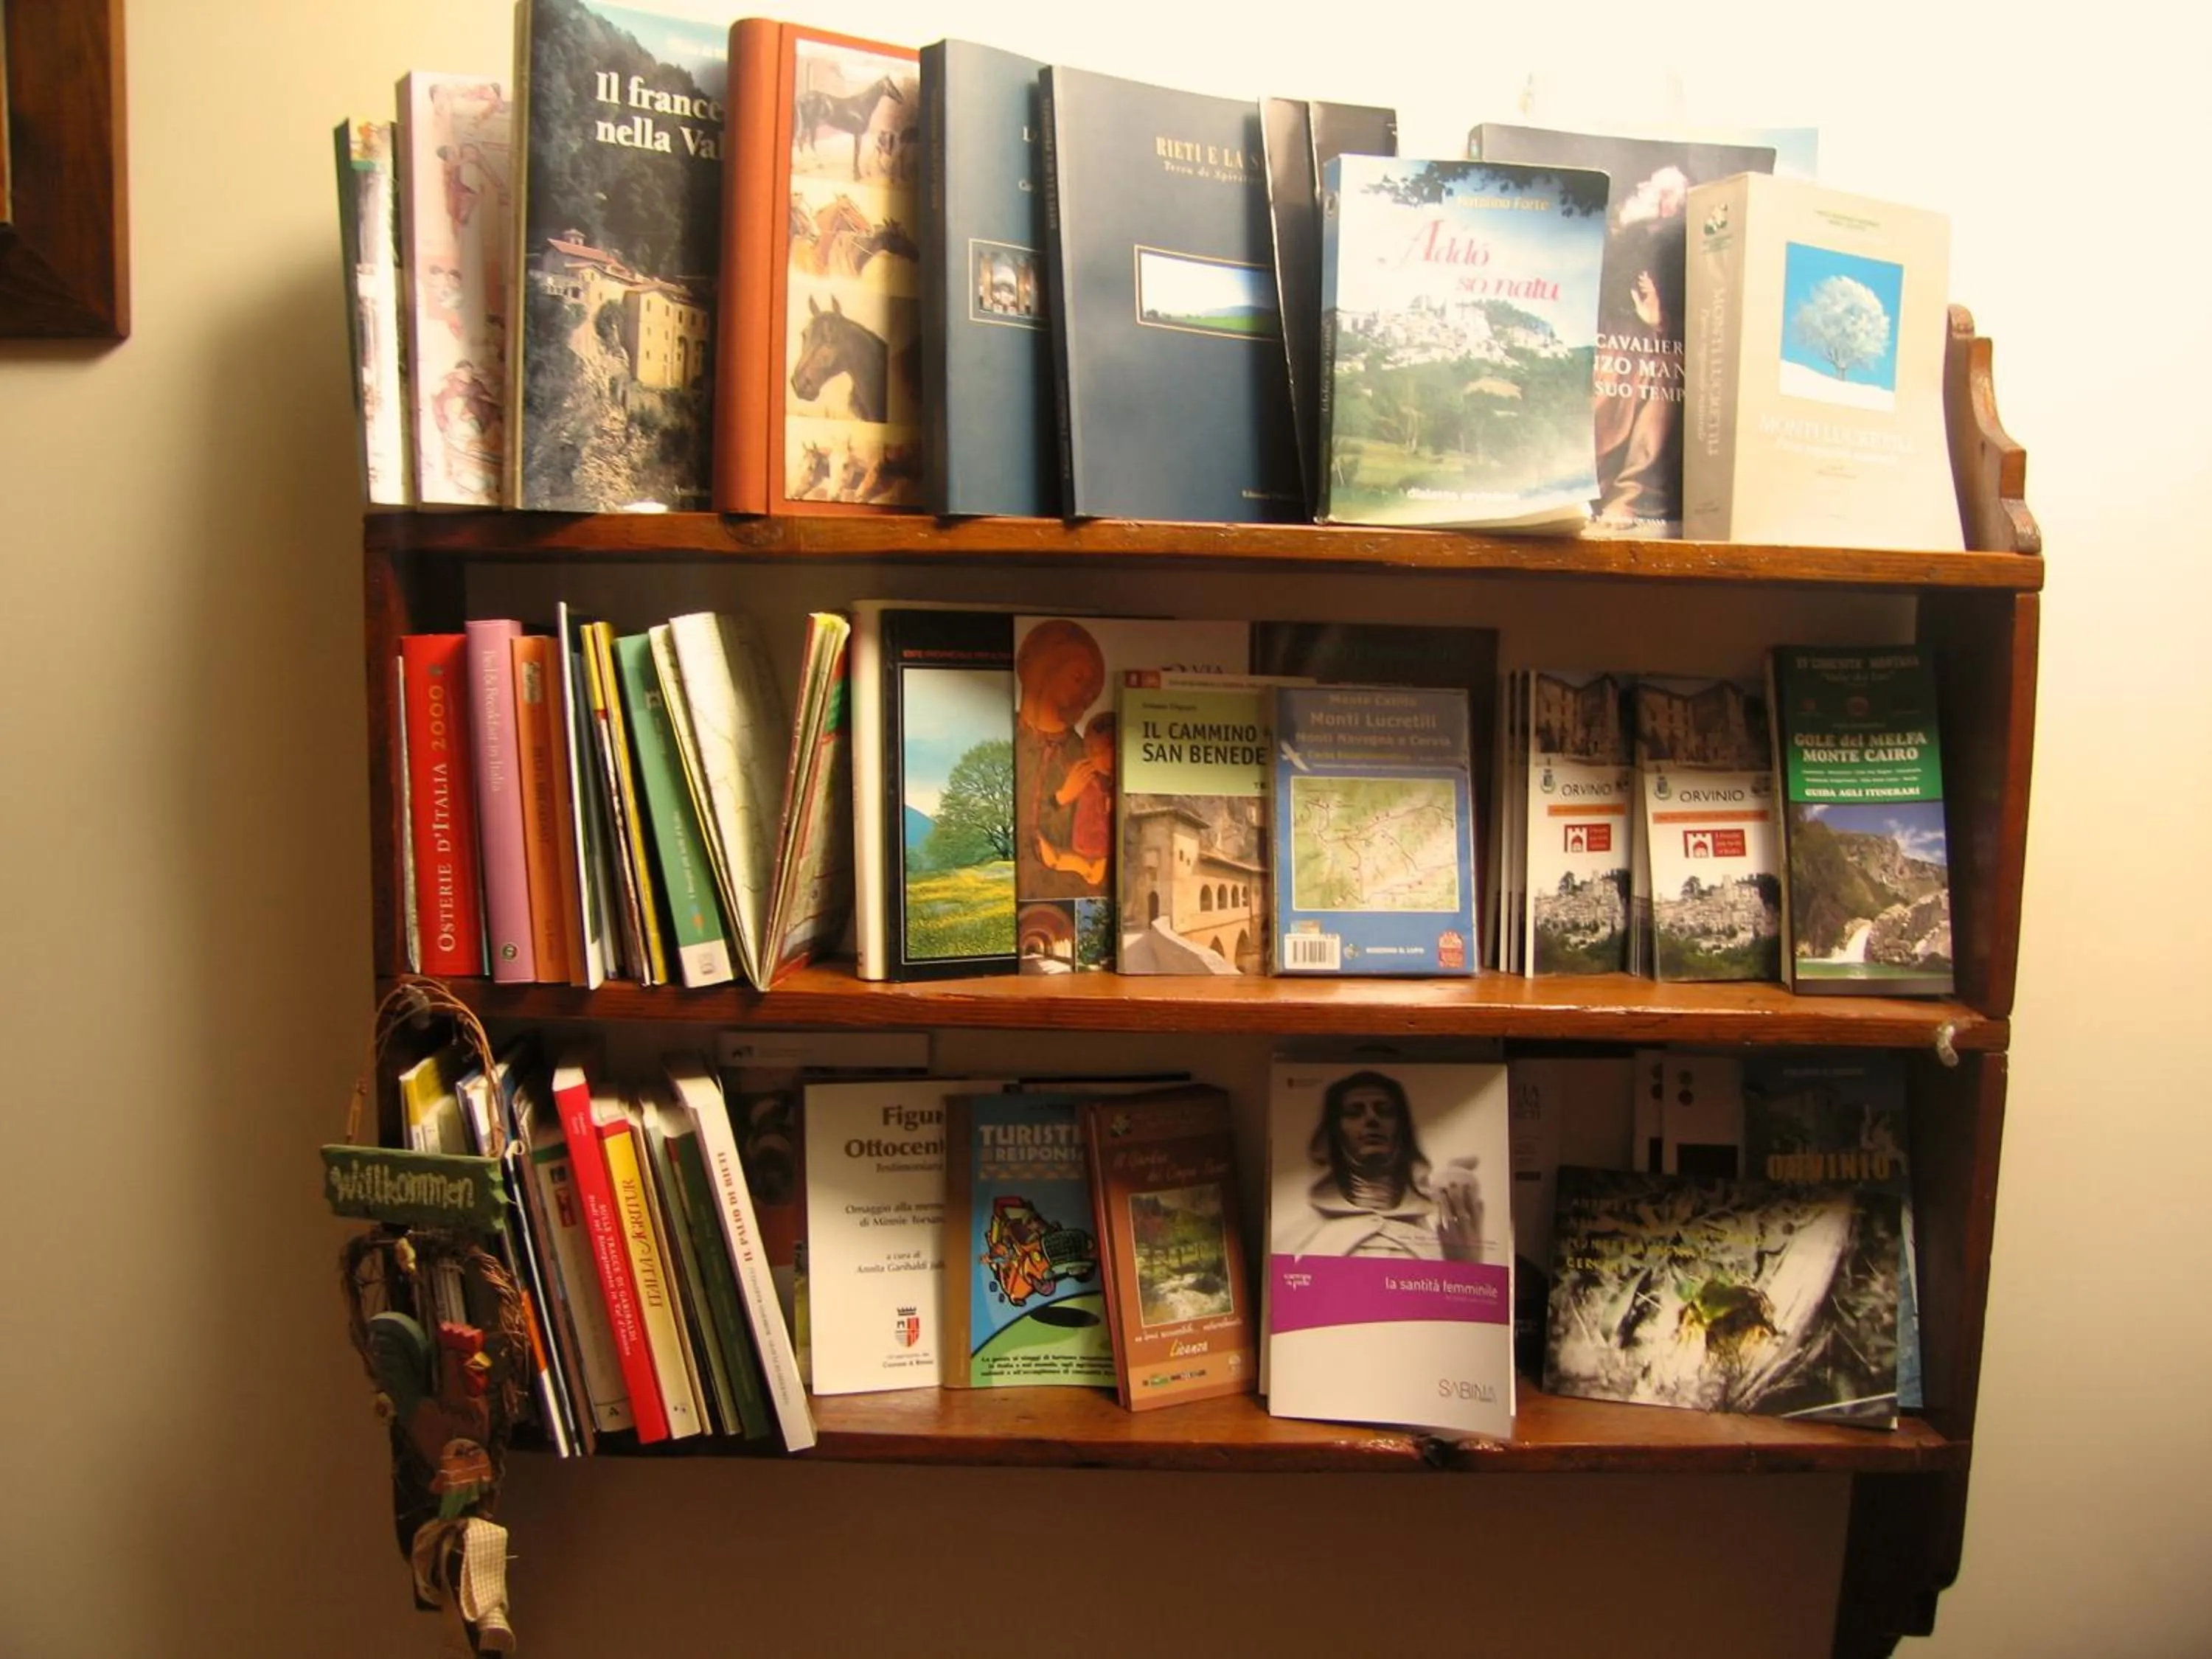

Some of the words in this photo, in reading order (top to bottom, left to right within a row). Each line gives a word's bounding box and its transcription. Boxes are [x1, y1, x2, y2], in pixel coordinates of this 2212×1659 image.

[595, 72, 621, 105] Il
[595, 116, 672, 154] nella
[1155, 136, 1201, 163] RIETI
[1207, 145, 1218, 166] E
[1223, 147, 1244, 170] LA
[1595, 333, 1683, 355] CAVALIER
[1594, 380, 1632, 398] SUO
[1142, 720, 1161, 740] IL
[1168, 722, 1258, 743] CAMMINO
[1310, 712, 1359, 727] Monti
[1365, 713, 1437, 729] Lucretili
[1142, 742, 1183, 762] SAN
[1189, 745, 1270, 767] BENEDE
[1802, 748, 1860, 763] MONTE
[1863, 746, 1920, 762] CAIRO
[1561, 783, 1613, 797] ORVINIO
[1679, 789, 1745, 804] ORVINIO
[437, 861, 457, 953] OSTERIE
[731, 1207, 748, 1246] PALIO
[639, 1256, 664, 1310] ITALIA
[1385, 1276, 1397, 1290] la
[1442, 1279, 1498, 1298] femminile
